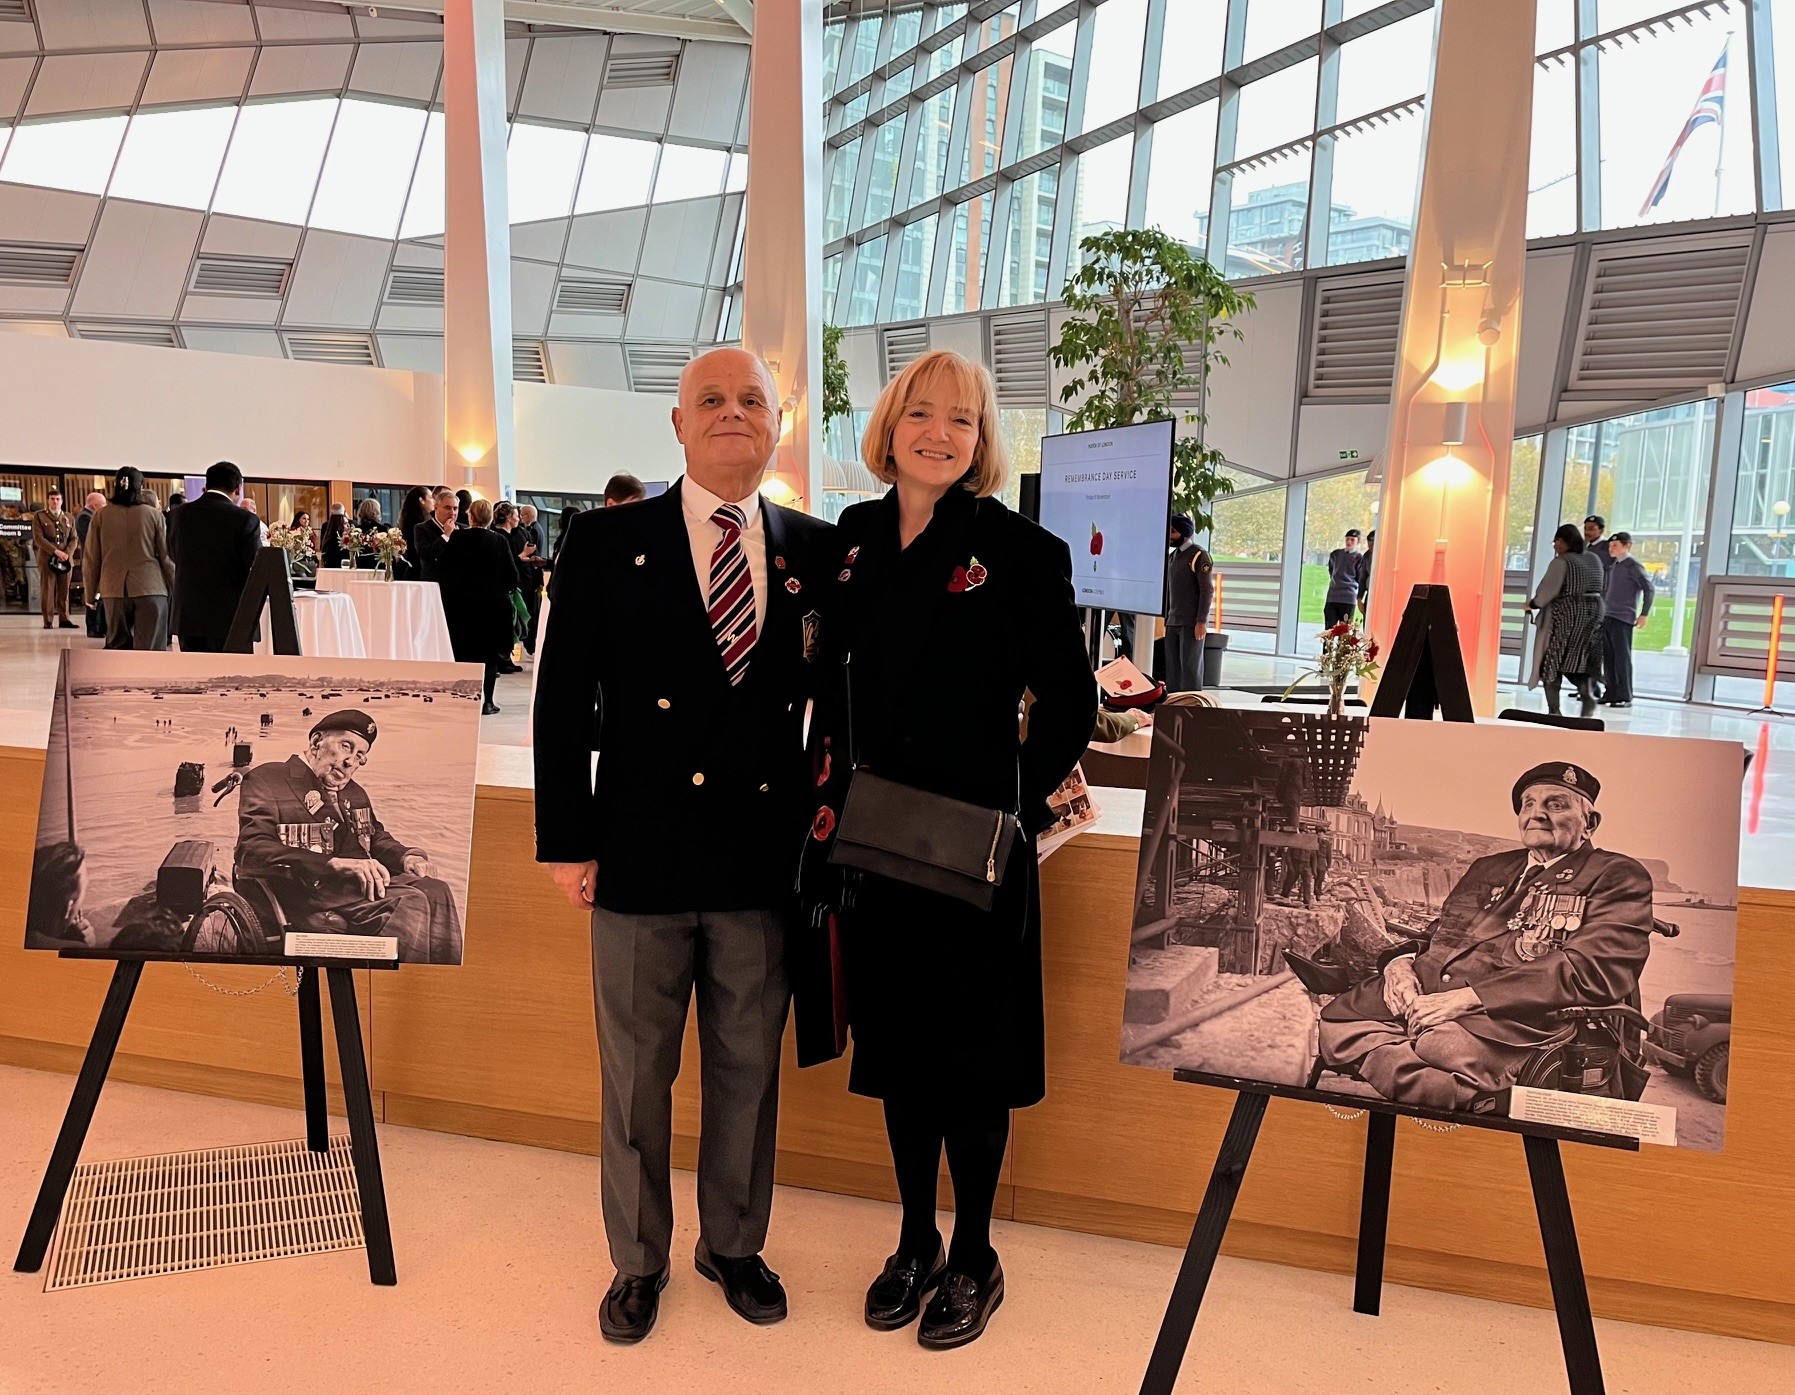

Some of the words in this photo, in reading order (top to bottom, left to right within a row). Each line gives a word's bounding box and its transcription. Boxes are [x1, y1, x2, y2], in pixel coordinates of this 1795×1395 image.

[1064, 472, 1101, 483] REMEMBRANCE
[1102, 471, 1113, 481] DAY
[1113, 469, 1137, 480] SERVICE
[0, 523, 32, 531] Committee
